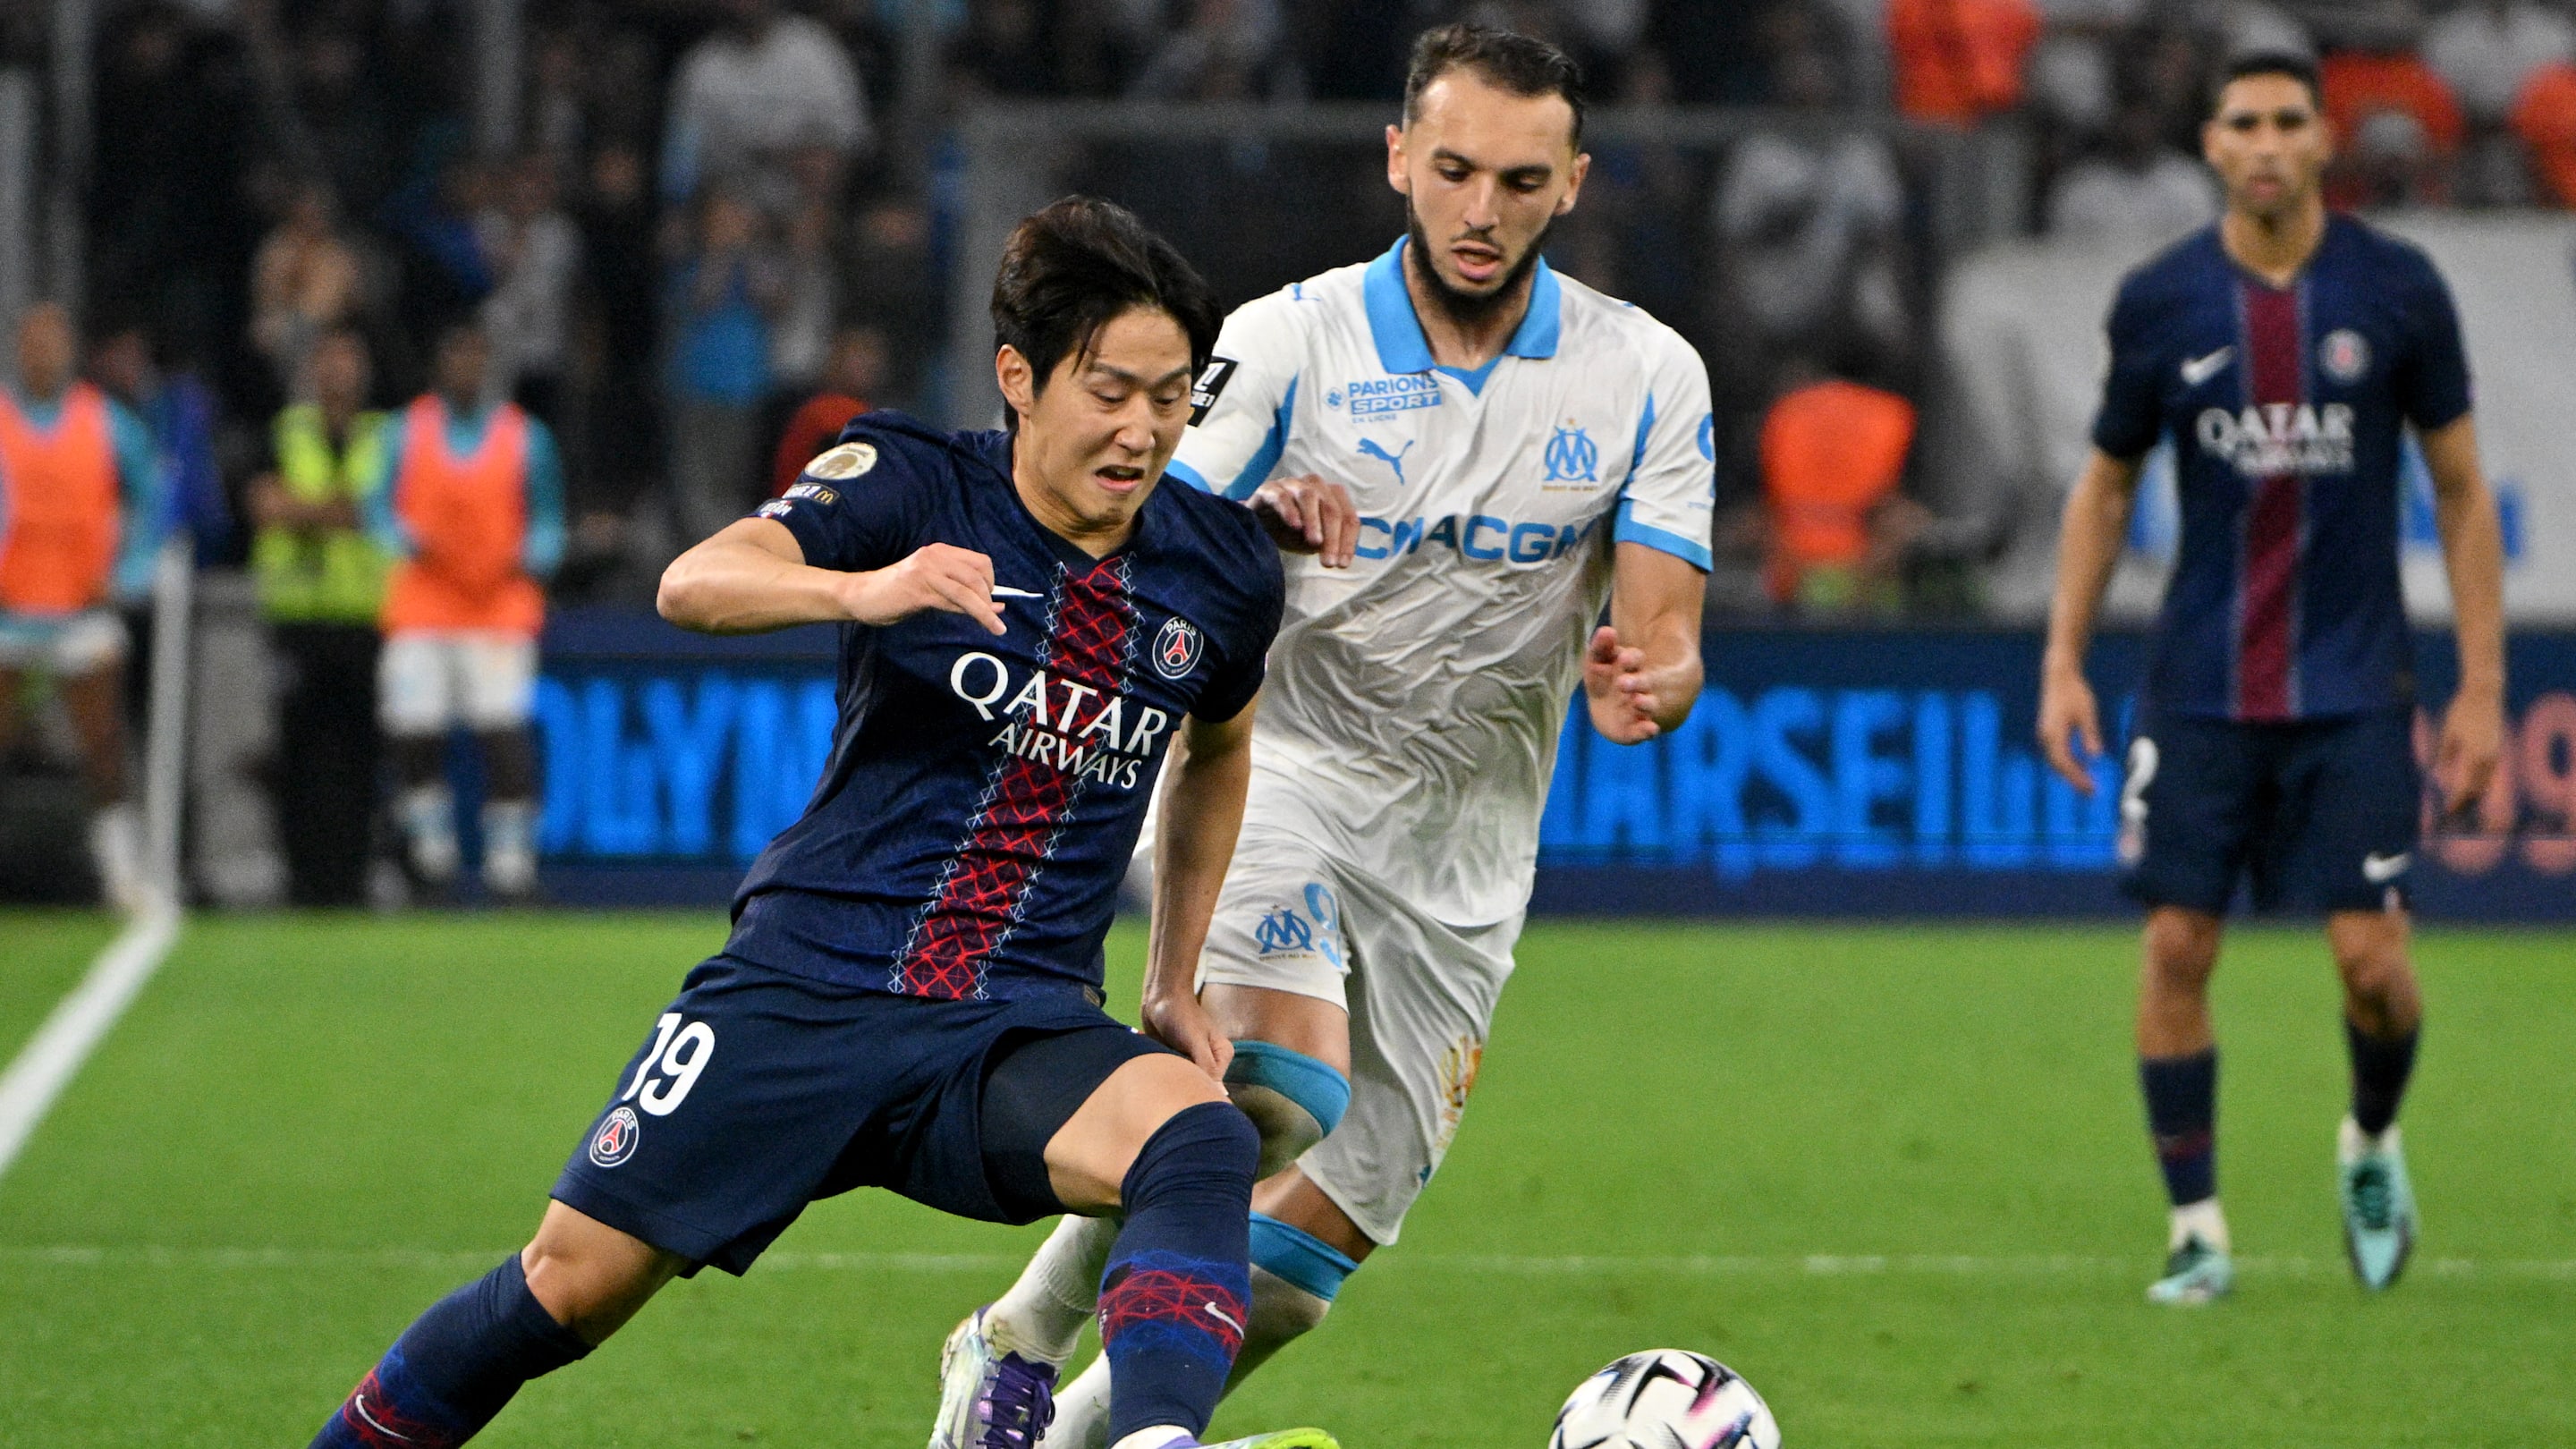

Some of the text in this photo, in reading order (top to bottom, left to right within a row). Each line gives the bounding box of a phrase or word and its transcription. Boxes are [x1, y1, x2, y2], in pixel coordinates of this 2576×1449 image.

[1348, 375, 1439, 397] PARIONS
[1353, 394, 1438, 412] SPORT
[2196, 402, 2356, 461] QATAR
[1165, 618, 1199, 636] PARIS
[950, 651, 1168, 757] QATAR
[987, 722, 1142, 789] AIRWAYS
[622, 1013, 716, 1116] 19
[612, 1109, 636, 1131] PARIS
